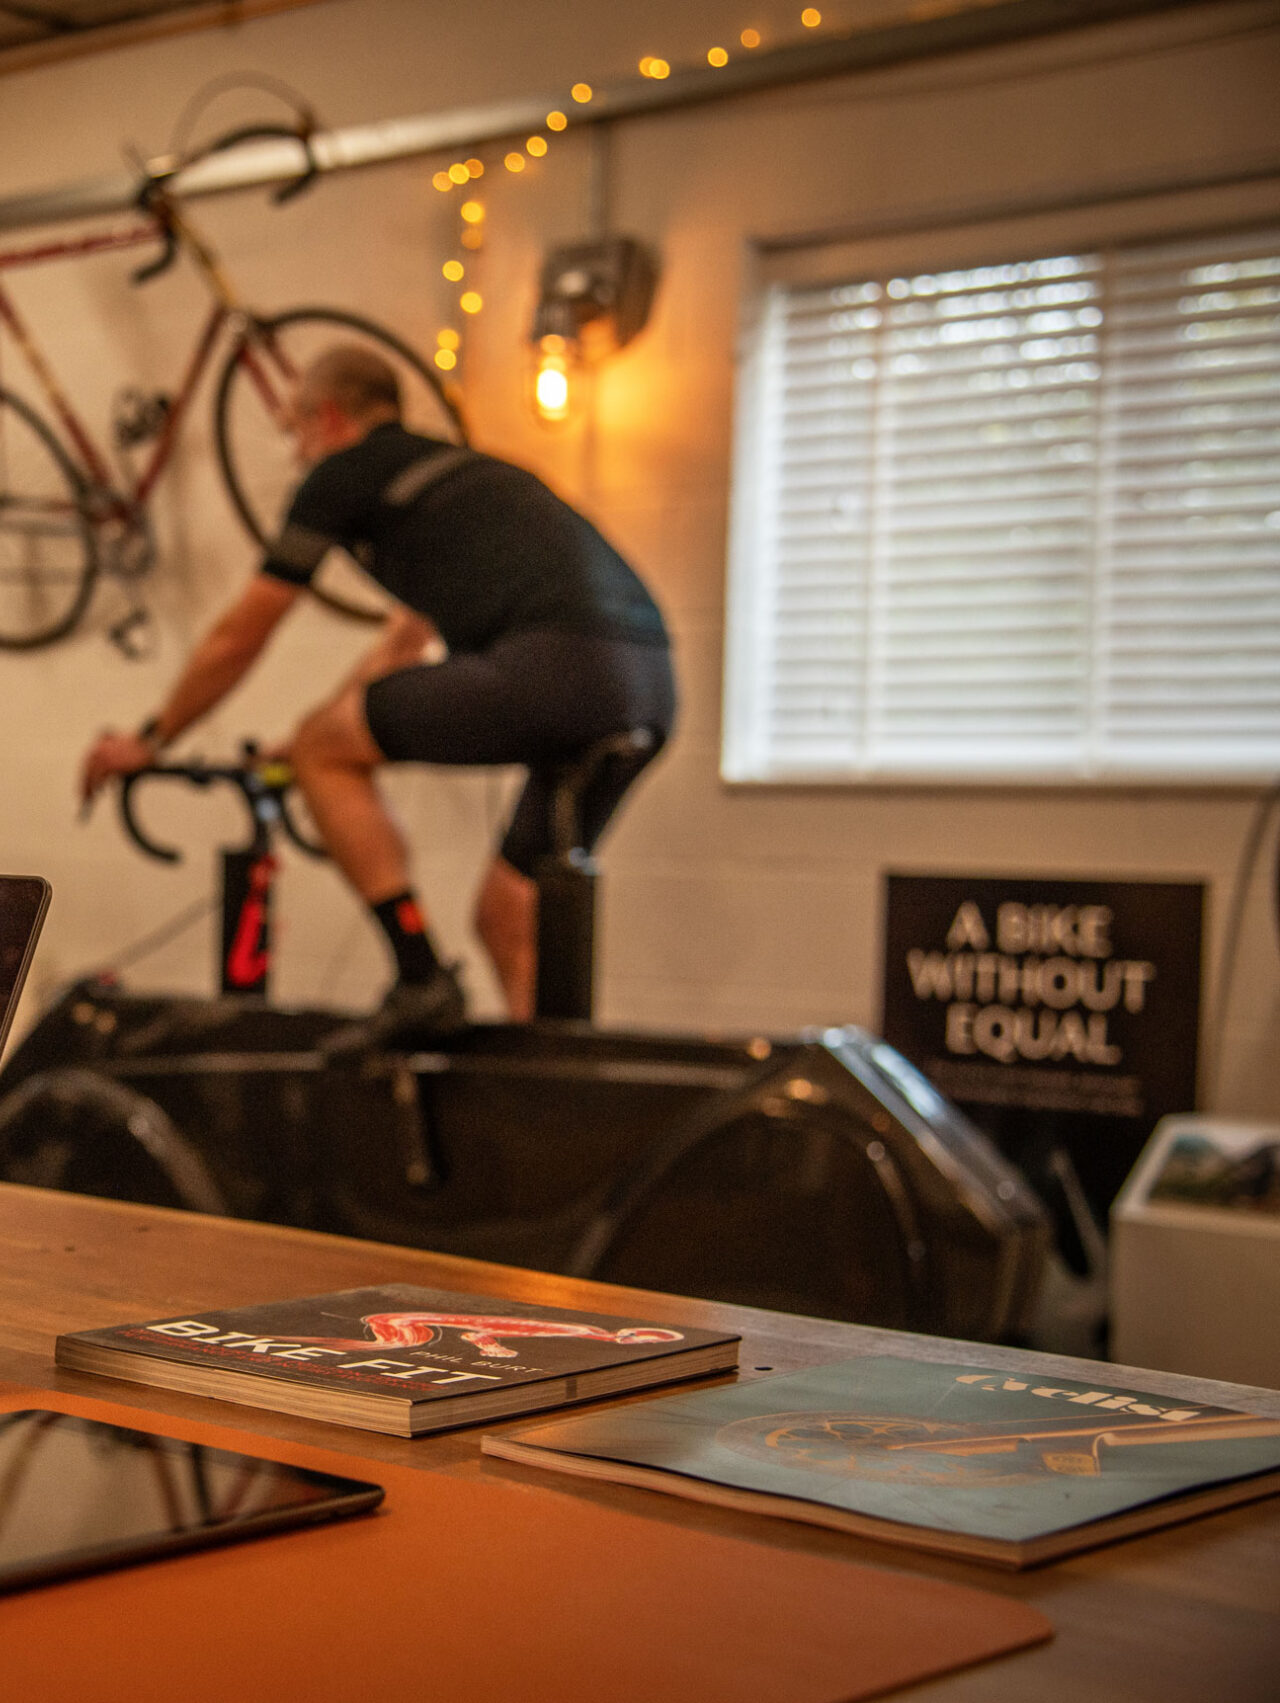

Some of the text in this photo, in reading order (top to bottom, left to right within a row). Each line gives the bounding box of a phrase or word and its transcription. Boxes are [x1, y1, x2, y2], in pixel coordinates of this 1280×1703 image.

[947, 901, 1114, 957] A BIKE
[907, 949, 1156, 1014] WITHOUT
[945, 1001, 1121, 1065] EQUAL
[146, 1320, 347, 1361] BIKE
[337, 1358, 502, 1385] FIT
[409, 1351, 545, 1374] PHIL BURT
[955, 1373, 1201, 1422] Cyclist
